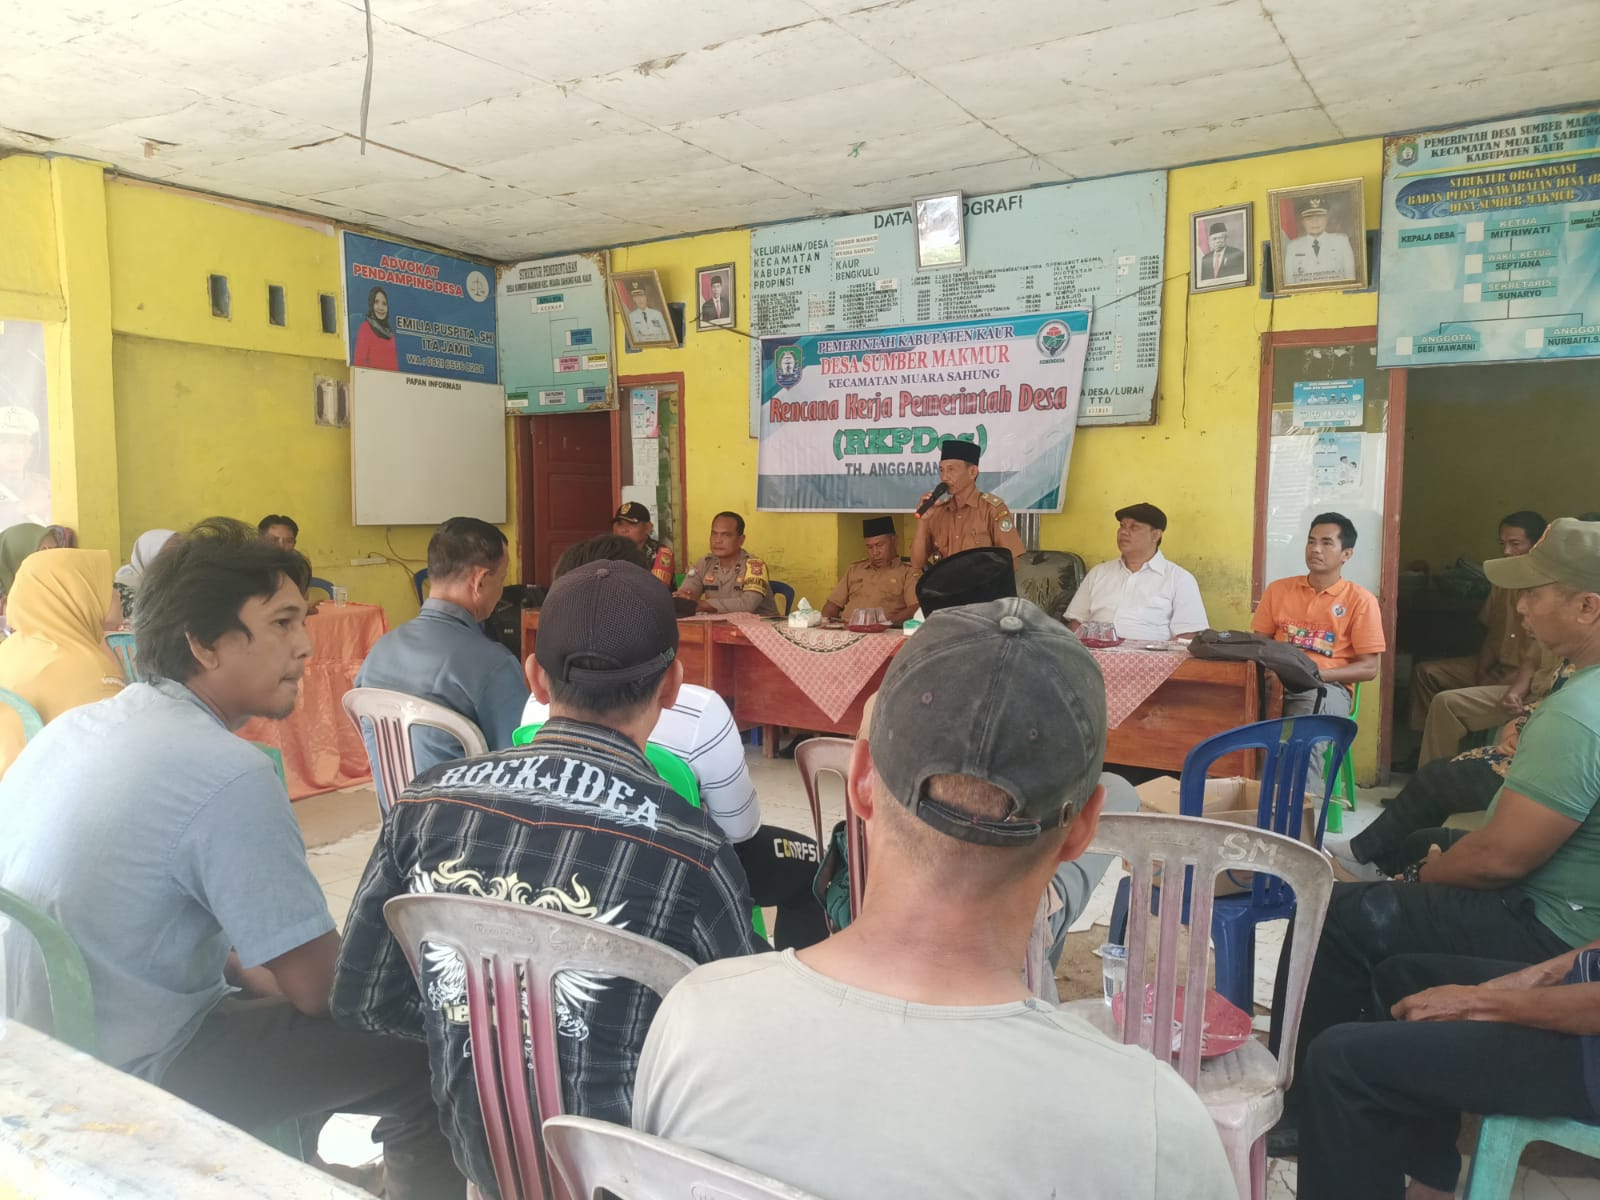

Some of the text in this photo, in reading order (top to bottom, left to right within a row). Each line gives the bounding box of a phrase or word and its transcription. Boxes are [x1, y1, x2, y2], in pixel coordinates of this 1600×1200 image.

[1424, 130, 1488, 149] PEMERINTAH
[1491, 127, 1516, 140] DESA
[1520, 120, 1562, 137] SUMBER
[1431, 141, 1500, 158] KECAMATAN
[1505, 134, 1548, 149] MUARA
[1466, 142, 1564, 163] KABUPATEN KAUR
[1450, 163, 1577, 187] STRUKTUR ORGANISASI
[1407, 191, 1443, 205] BADAN
[1479, 195, 1522, 209] SUMBER
[1526, 190, 1575, 205] MAKMUR
[874, 211, 912, 229] DATA
[1499, 217, 1537, 228] KETUA
[1401, 231, 1455, 243] KEPALA DESA
[1490, 226, 1551, 239] MITRIWATI
[753, 240, 829, 257] KELURAHAN/DESA
[380, 254, 440, 277] ADVOKAT
[753, 252, 820, 268] KECAMATAN
[836, 258, 860, 270] KAUR
[1495, 260, 1541, 271] SEPTIANA
[753, 265, 811, 279] KABUPATEN
[836, 267, 880, 281] BENGKULU
[352, 263, 464, 299] PENDAMPING DESA
[753, 278, 794, 290] PROPINSI
[1497, 289, 1542, 300] SUNARYO
[395, 316, 432, 334] EMILIA
[479, 328, 495, 344] SH
[421, 337, 473, 358] ITA JAMIL
[817, 326, 1015, 354] PEMERINTAH KABUPATEN KAUR
[1417, 343, 1476, 353] DESI MAWARNI
[820, 344, 1011, 376] DESA SUMBER MAKMUR
[406, 377, 462, 391] PAPAN INFORMASI
[828, 368, 1000, 389] KECAMATAN MUARA SAHUNG
[1087, 386, 1145, 397] DESA/LURAH
[770, 383, 1068, 423] Rencana Kerja Pemerintah Desa
[845, 461, 940, 477] TH. ANGGARAN
[437, 755, 660, 831] ROCK IDEA
[1218, 832, 1279, 865] SM
